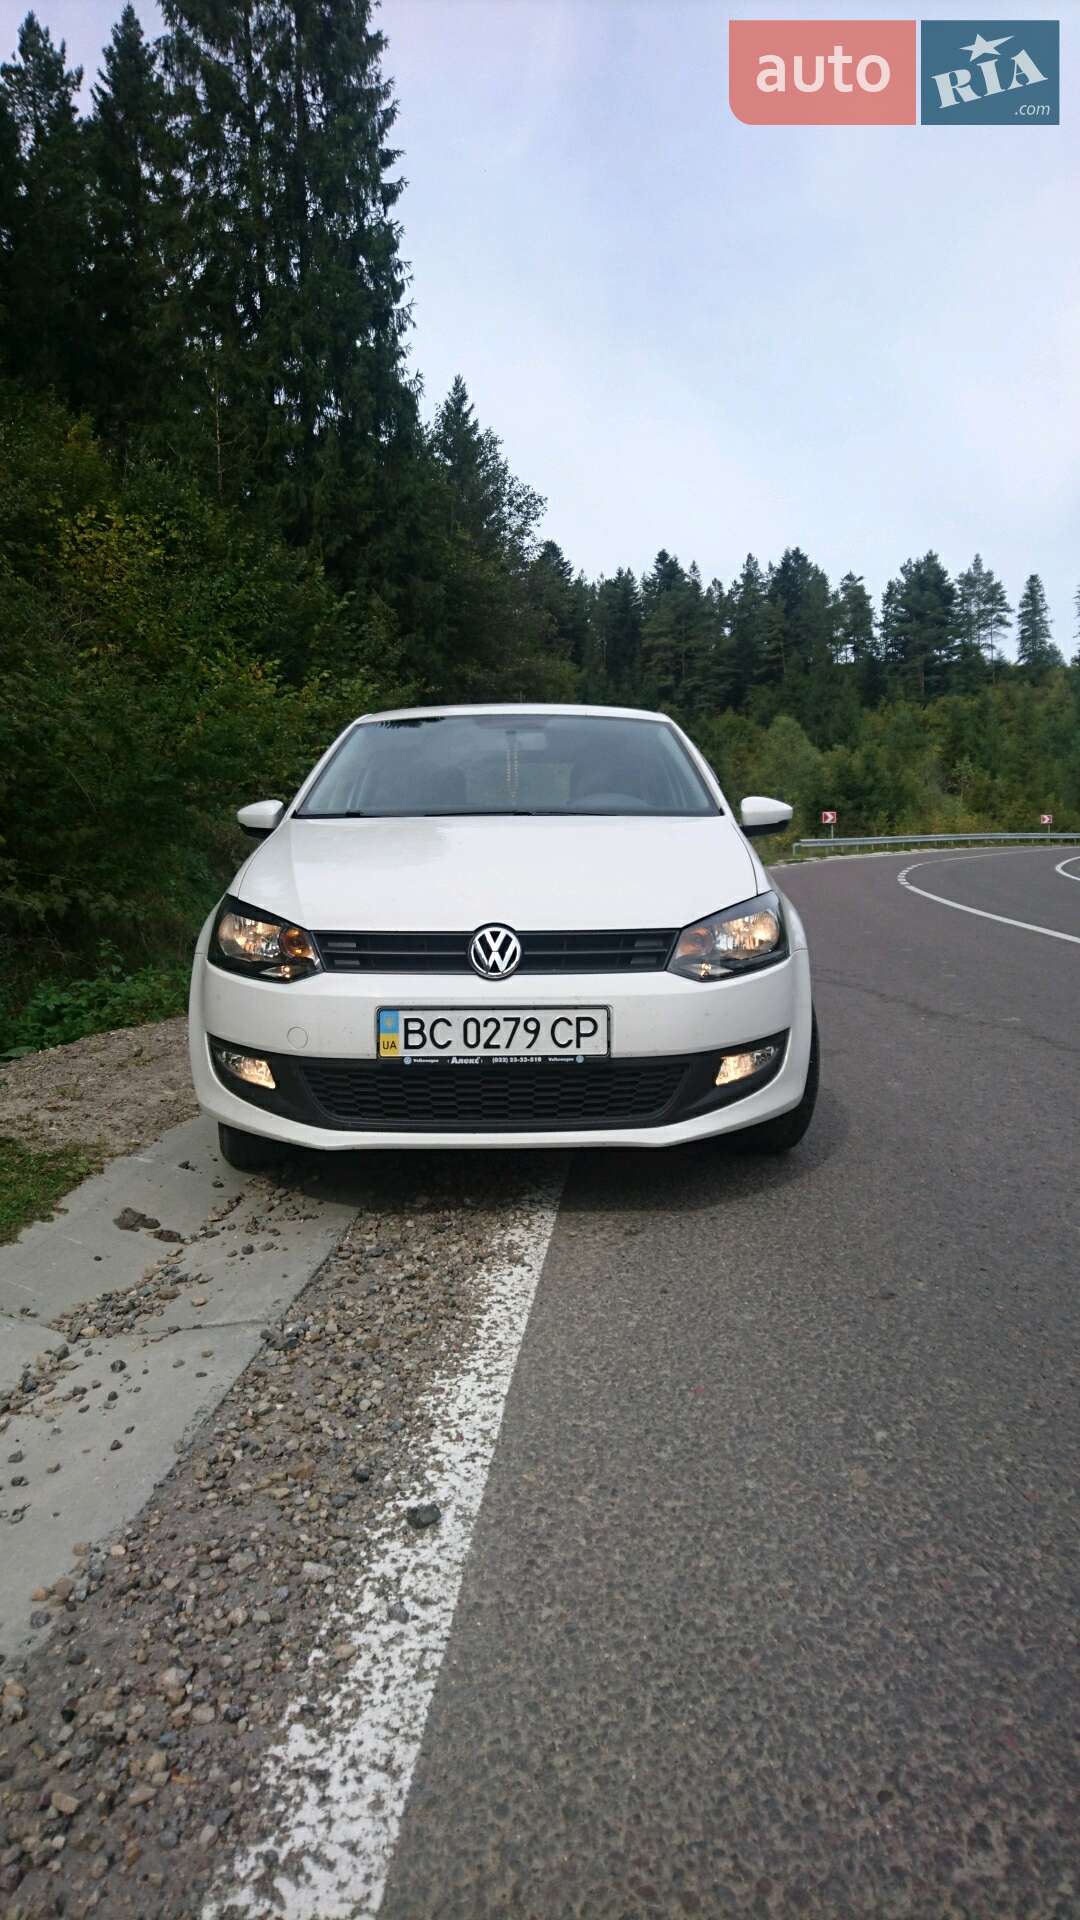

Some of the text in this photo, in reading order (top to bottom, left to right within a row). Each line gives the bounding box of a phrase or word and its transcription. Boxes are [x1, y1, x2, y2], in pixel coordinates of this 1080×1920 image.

[403, 1016, 599, 1050] BC 0279 CP
[382, 1040, 397, 1050] UA
